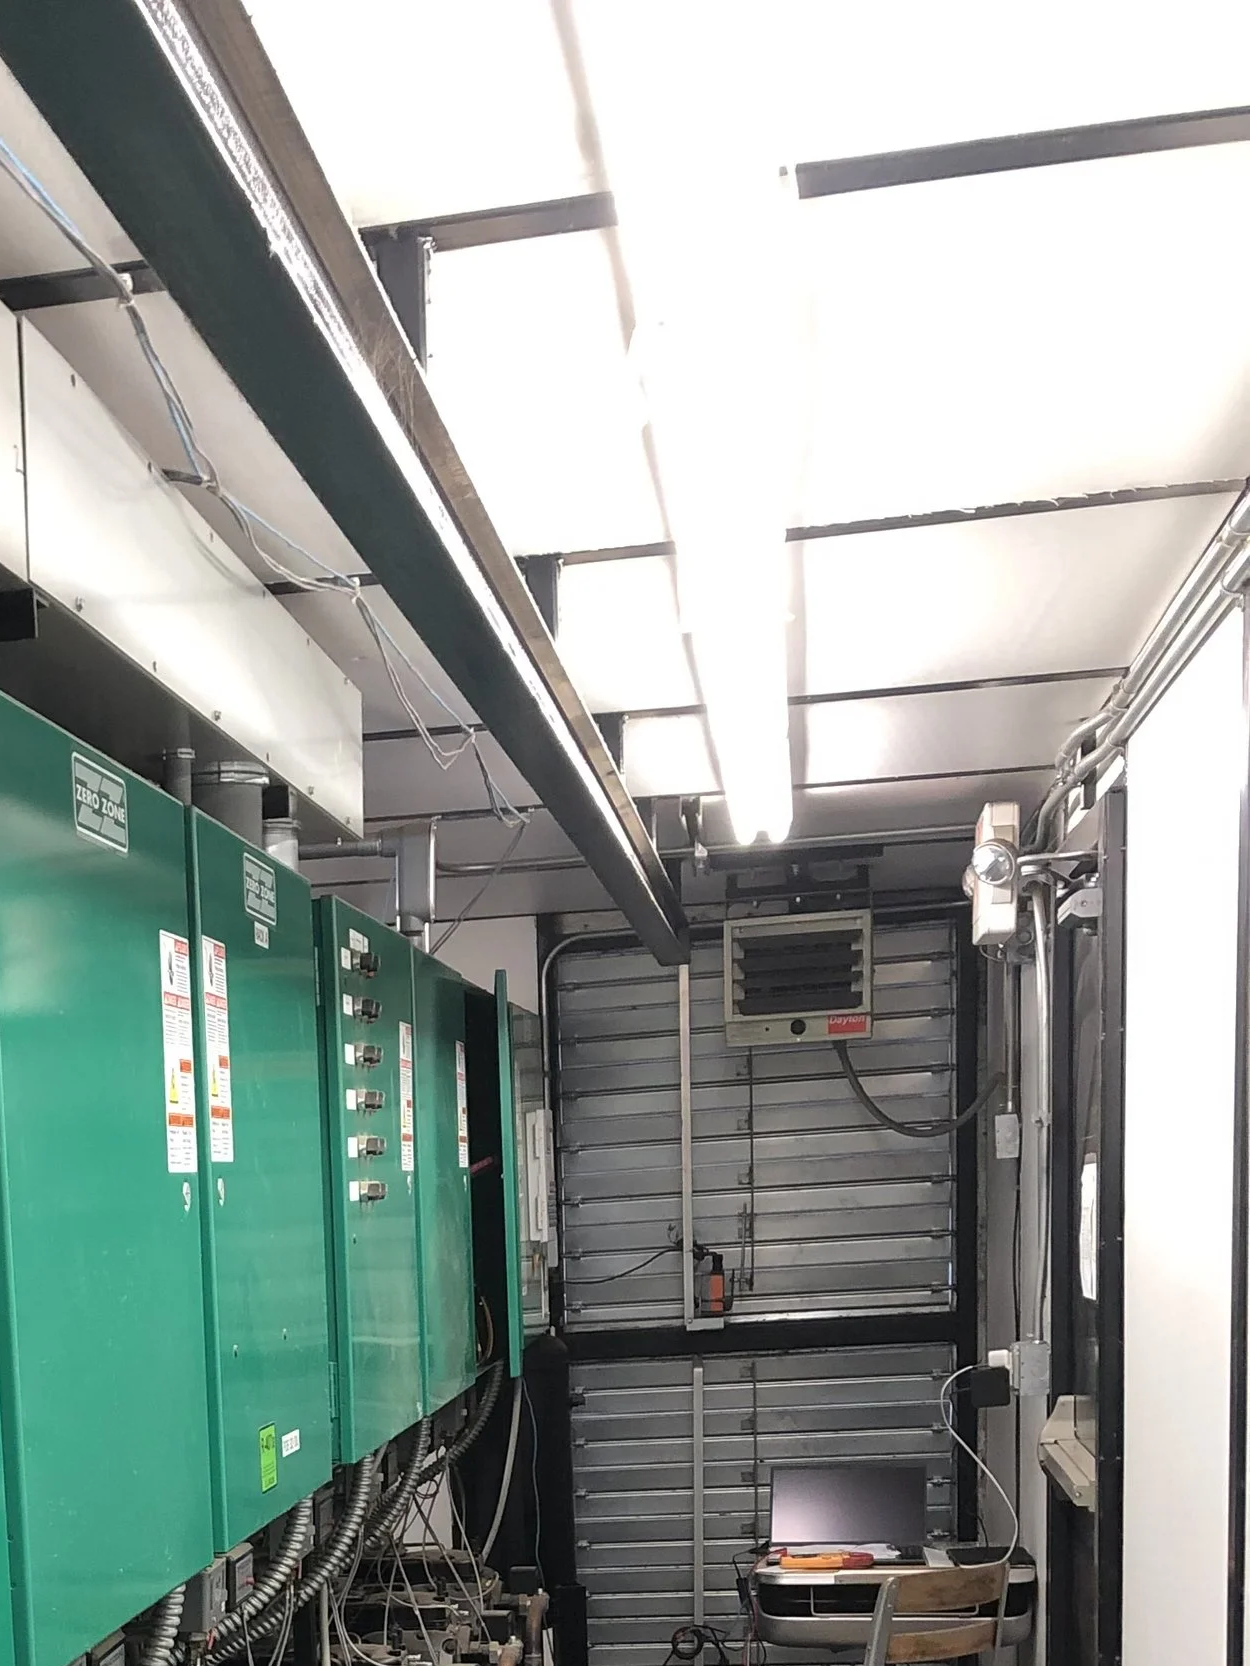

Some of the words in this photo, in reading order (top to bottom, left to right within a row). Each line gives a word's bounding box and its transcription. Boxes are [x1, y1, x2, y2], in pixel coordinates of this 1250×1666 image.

[76, 784, 100, 809] ZERO
[101, 798, 126, 823] ZONE
[830, 1015, 866, 1025] Dayton
